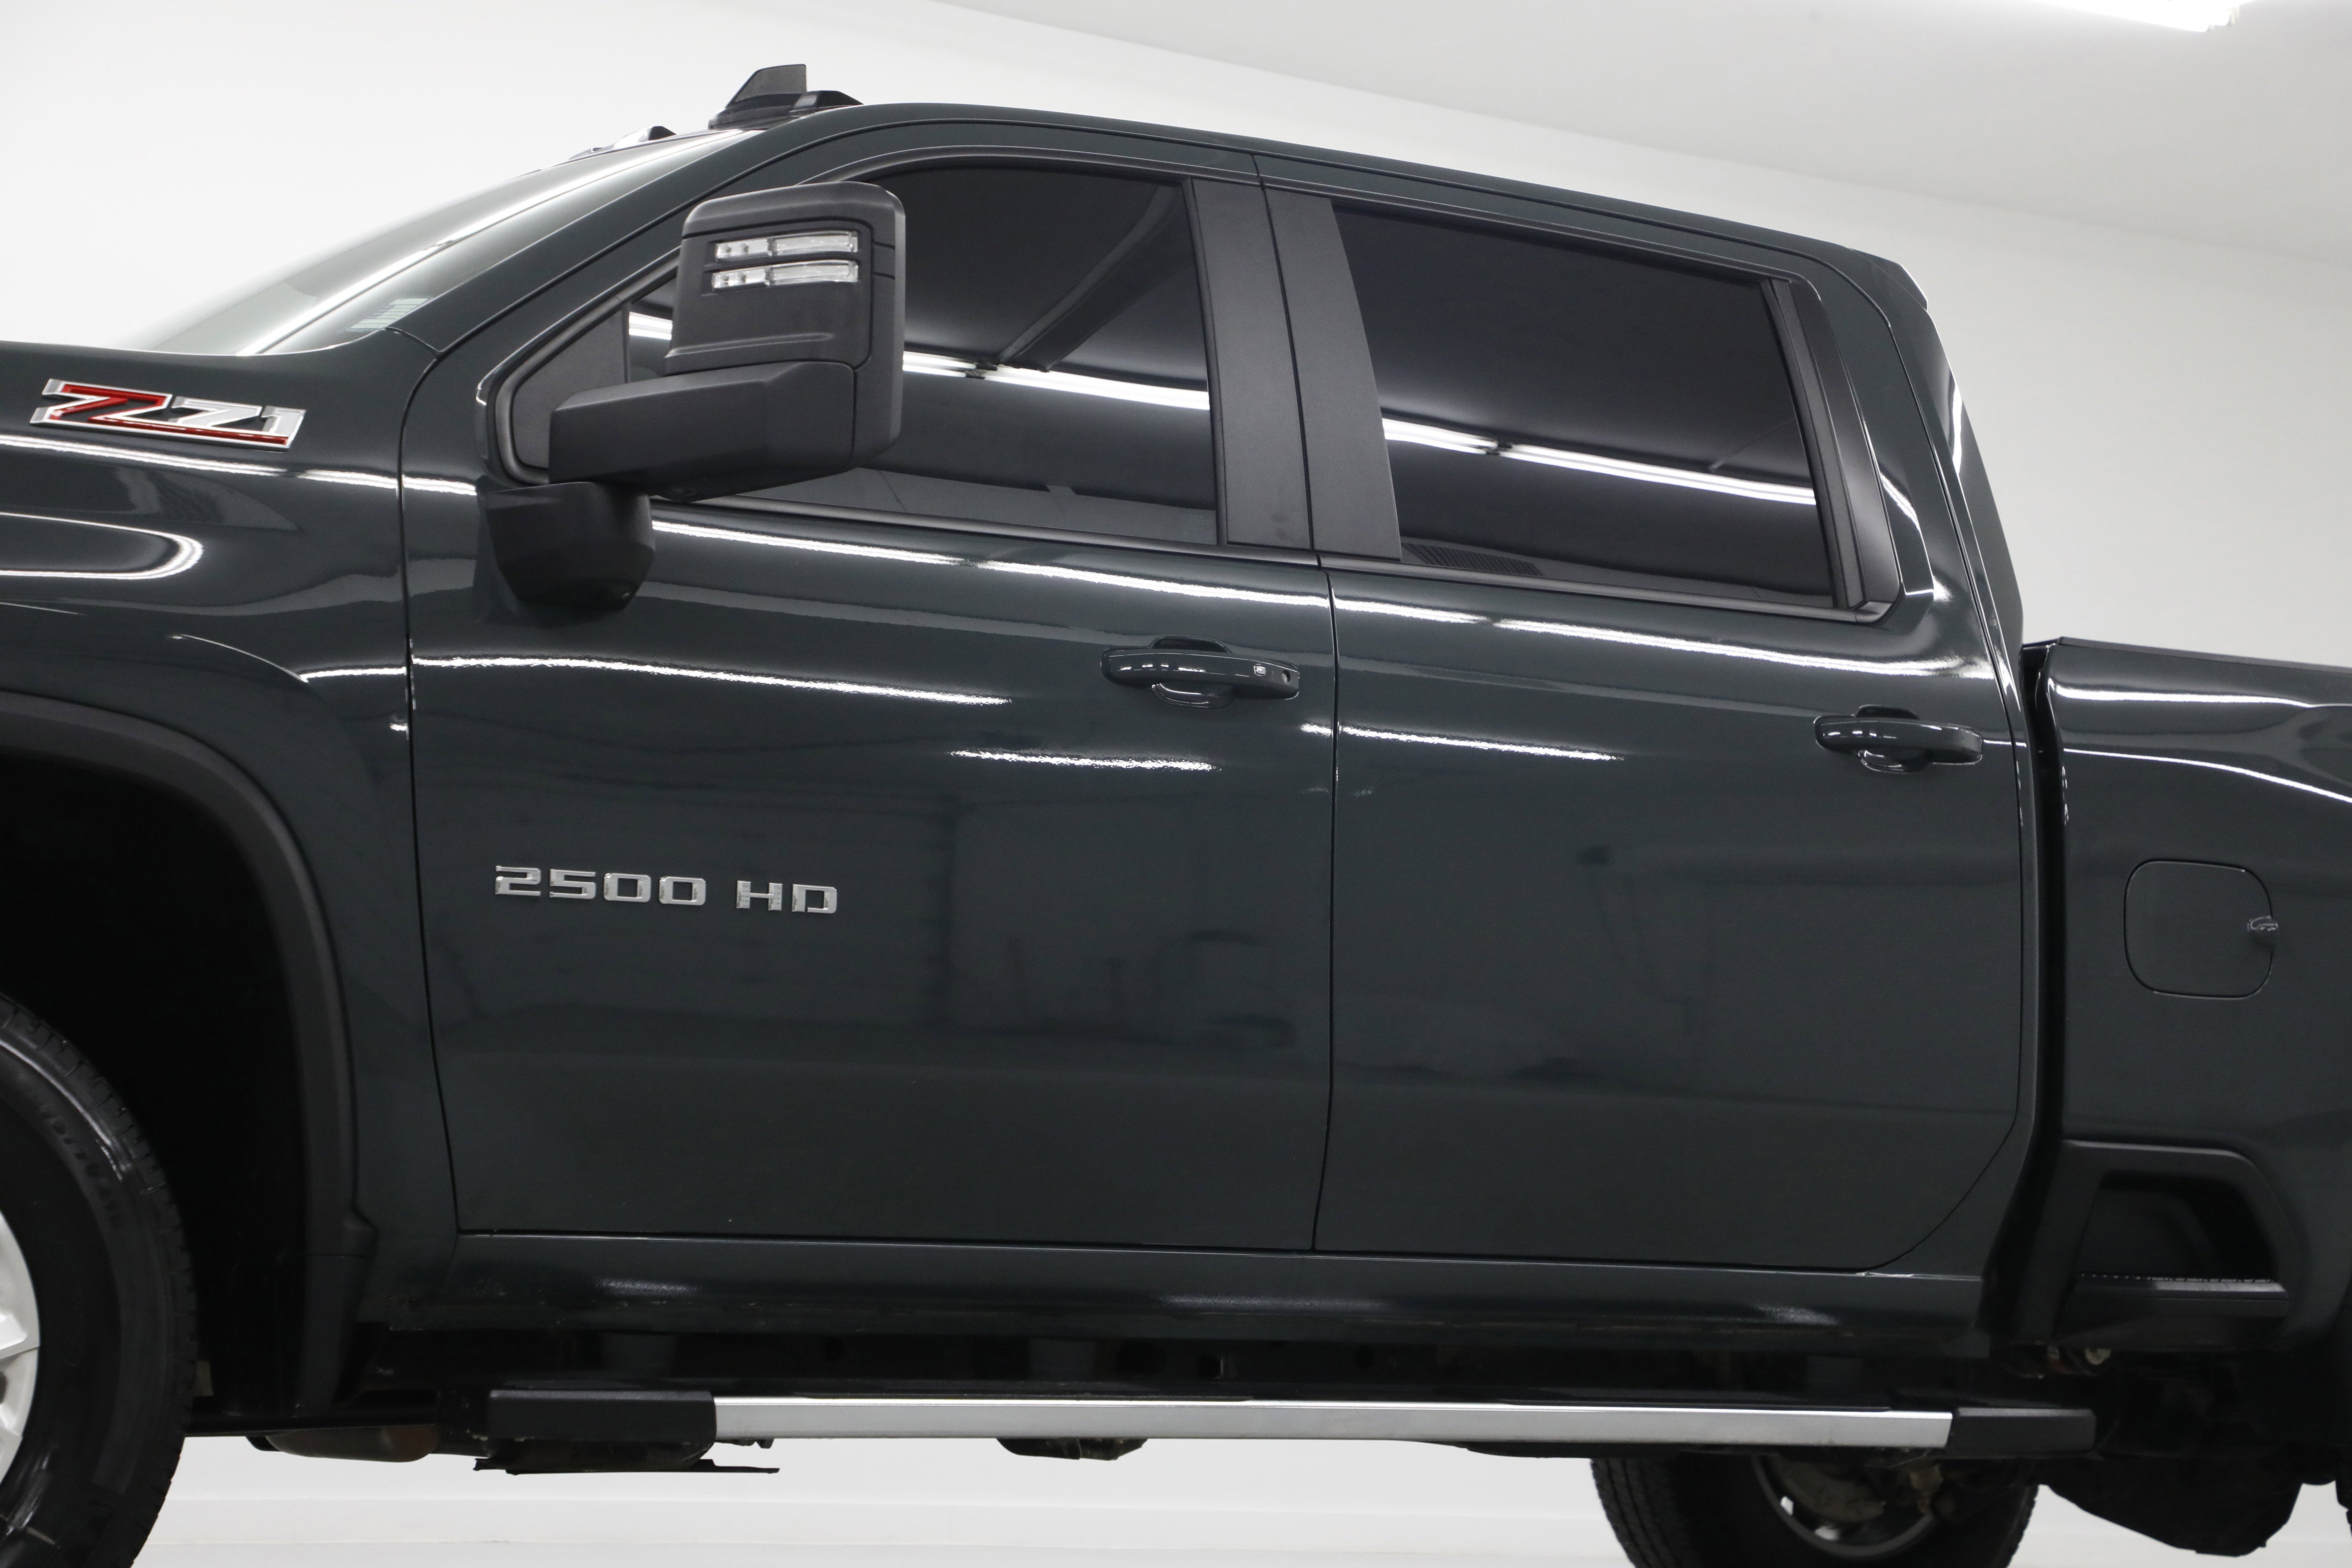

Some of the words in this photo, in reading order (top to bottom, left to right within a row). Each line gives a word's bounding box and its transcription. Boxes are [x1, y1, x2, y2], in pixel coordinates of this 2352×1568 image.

[30, 379, 306, 451] Z71
[494, 865, 706, 906] 2500
[736, 880, 837, 914] HD
